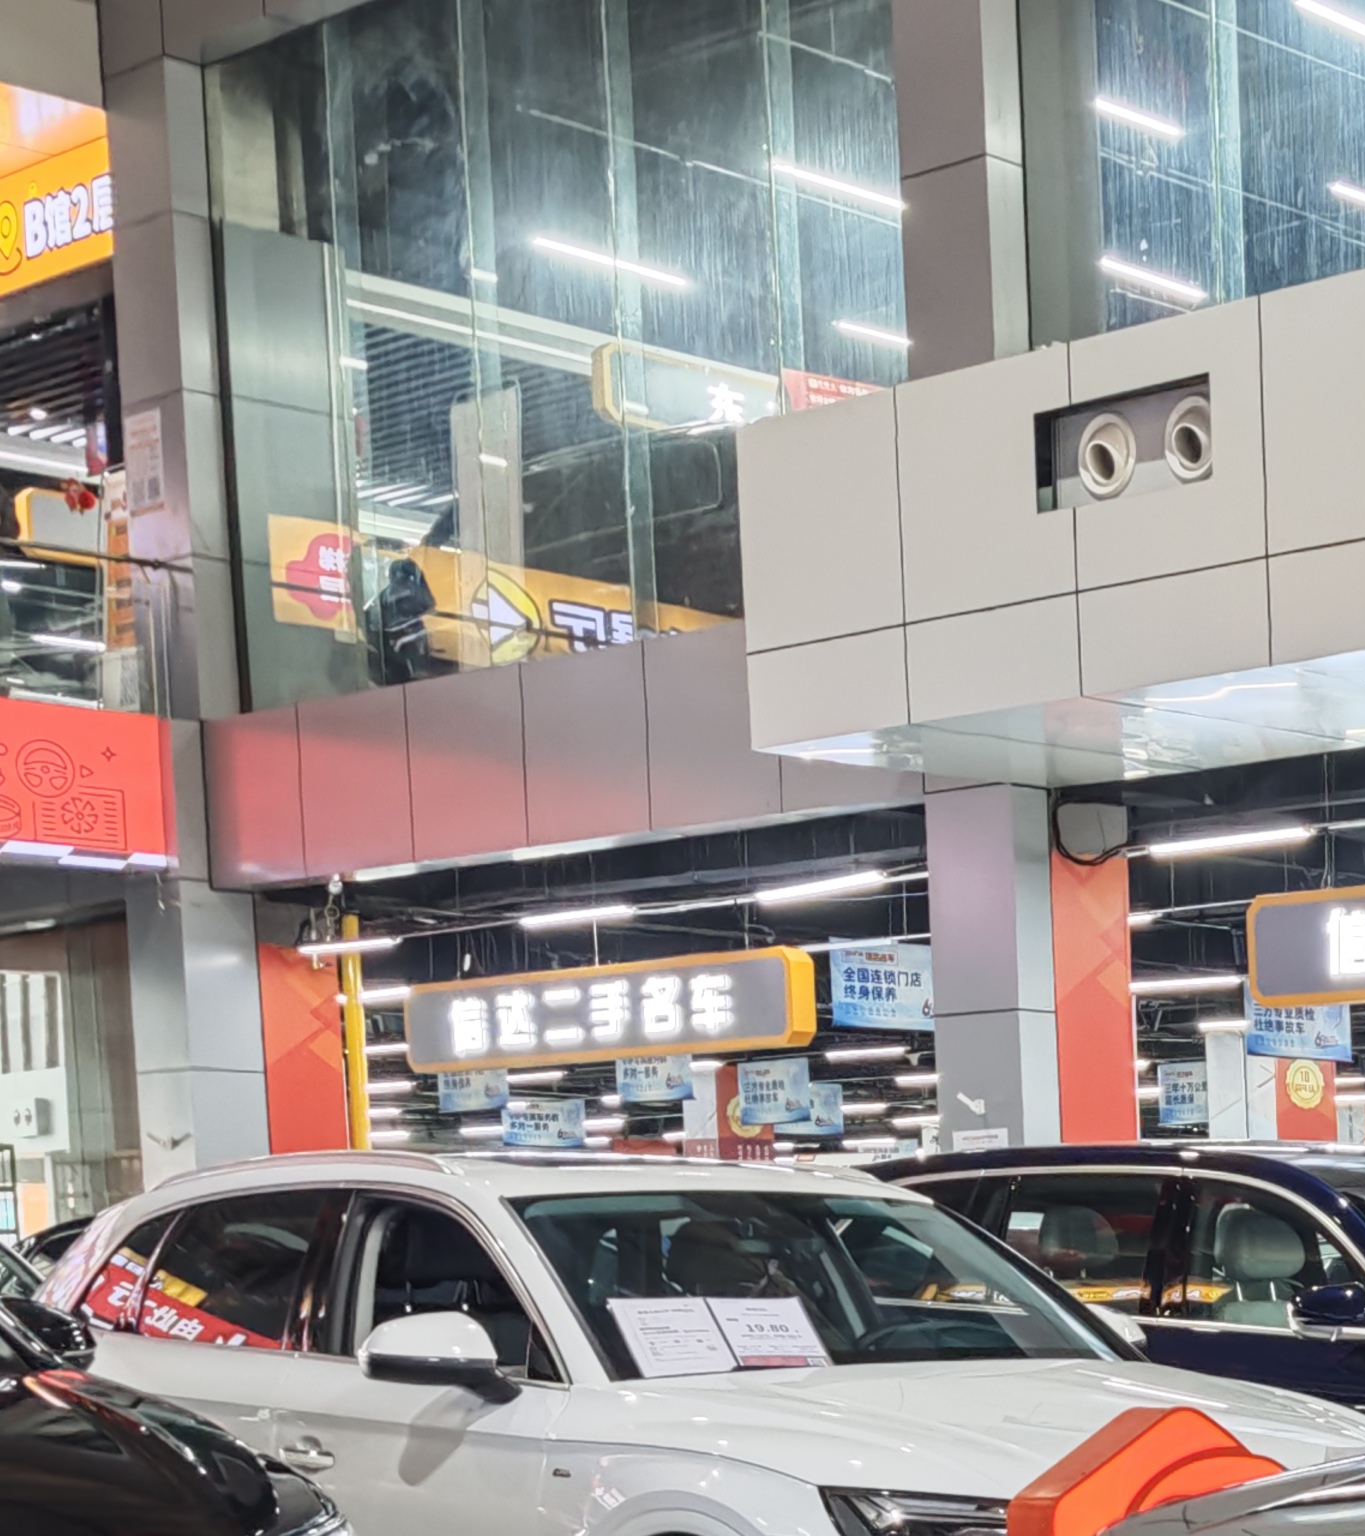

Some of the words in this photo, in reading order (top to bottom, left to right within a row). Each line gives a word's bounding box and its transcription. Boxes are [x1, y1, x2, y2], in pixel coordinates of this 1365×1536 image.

[842, 966, 922, 988] 全国连锁门店
[843, 984, 898, 1003] 终身保养
[449, 974, 735, 1056] 信达二手名车
[1254, 1019, 1306, 1034] 杜绝事故车
